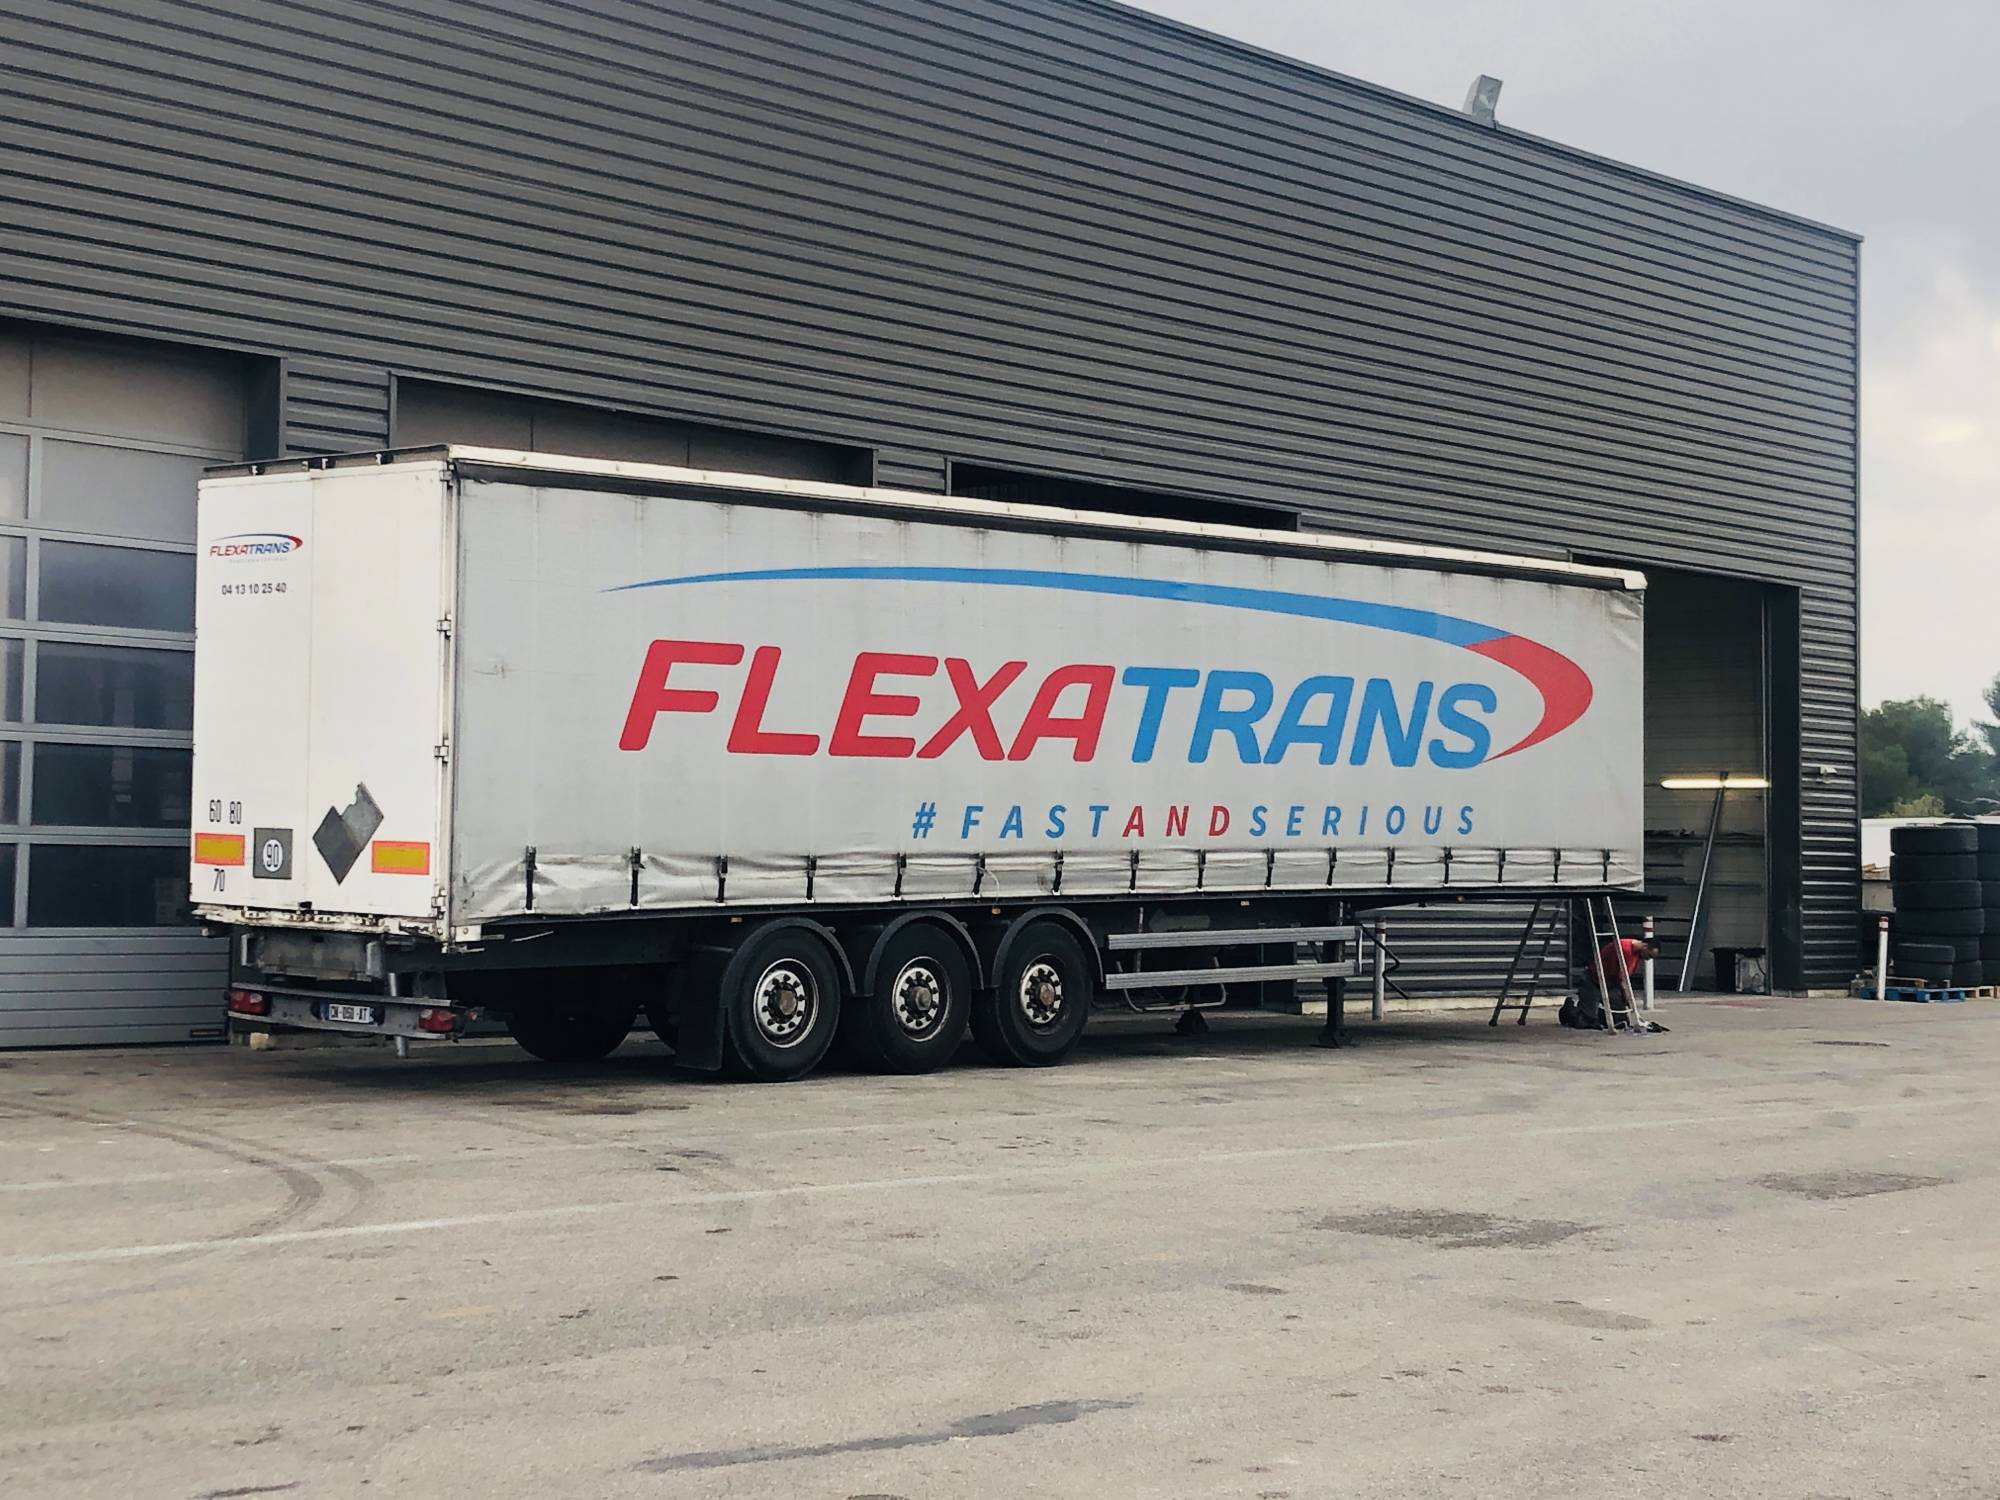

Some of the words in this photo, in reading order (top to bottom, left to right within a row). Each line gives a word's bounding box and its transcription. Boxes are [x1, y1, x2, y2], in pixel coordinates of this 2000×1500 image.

[210, 542, 291, 556] FLEXATRANS
[221, 584, 232, 595] 04
[235, 584, 246, 595] 13
[249, 583, 259, 594] 10
[261, 583, 273, 594] 25
[275, 582, 287, 593] 40
[619, 640, 1497, 769] FLEXATRANS
[209, 799, 221, 822] 60
[229, 801, 242, 824] 80
[266, 843, 279, 868] 90
[213, 868, 225, 892] 70
